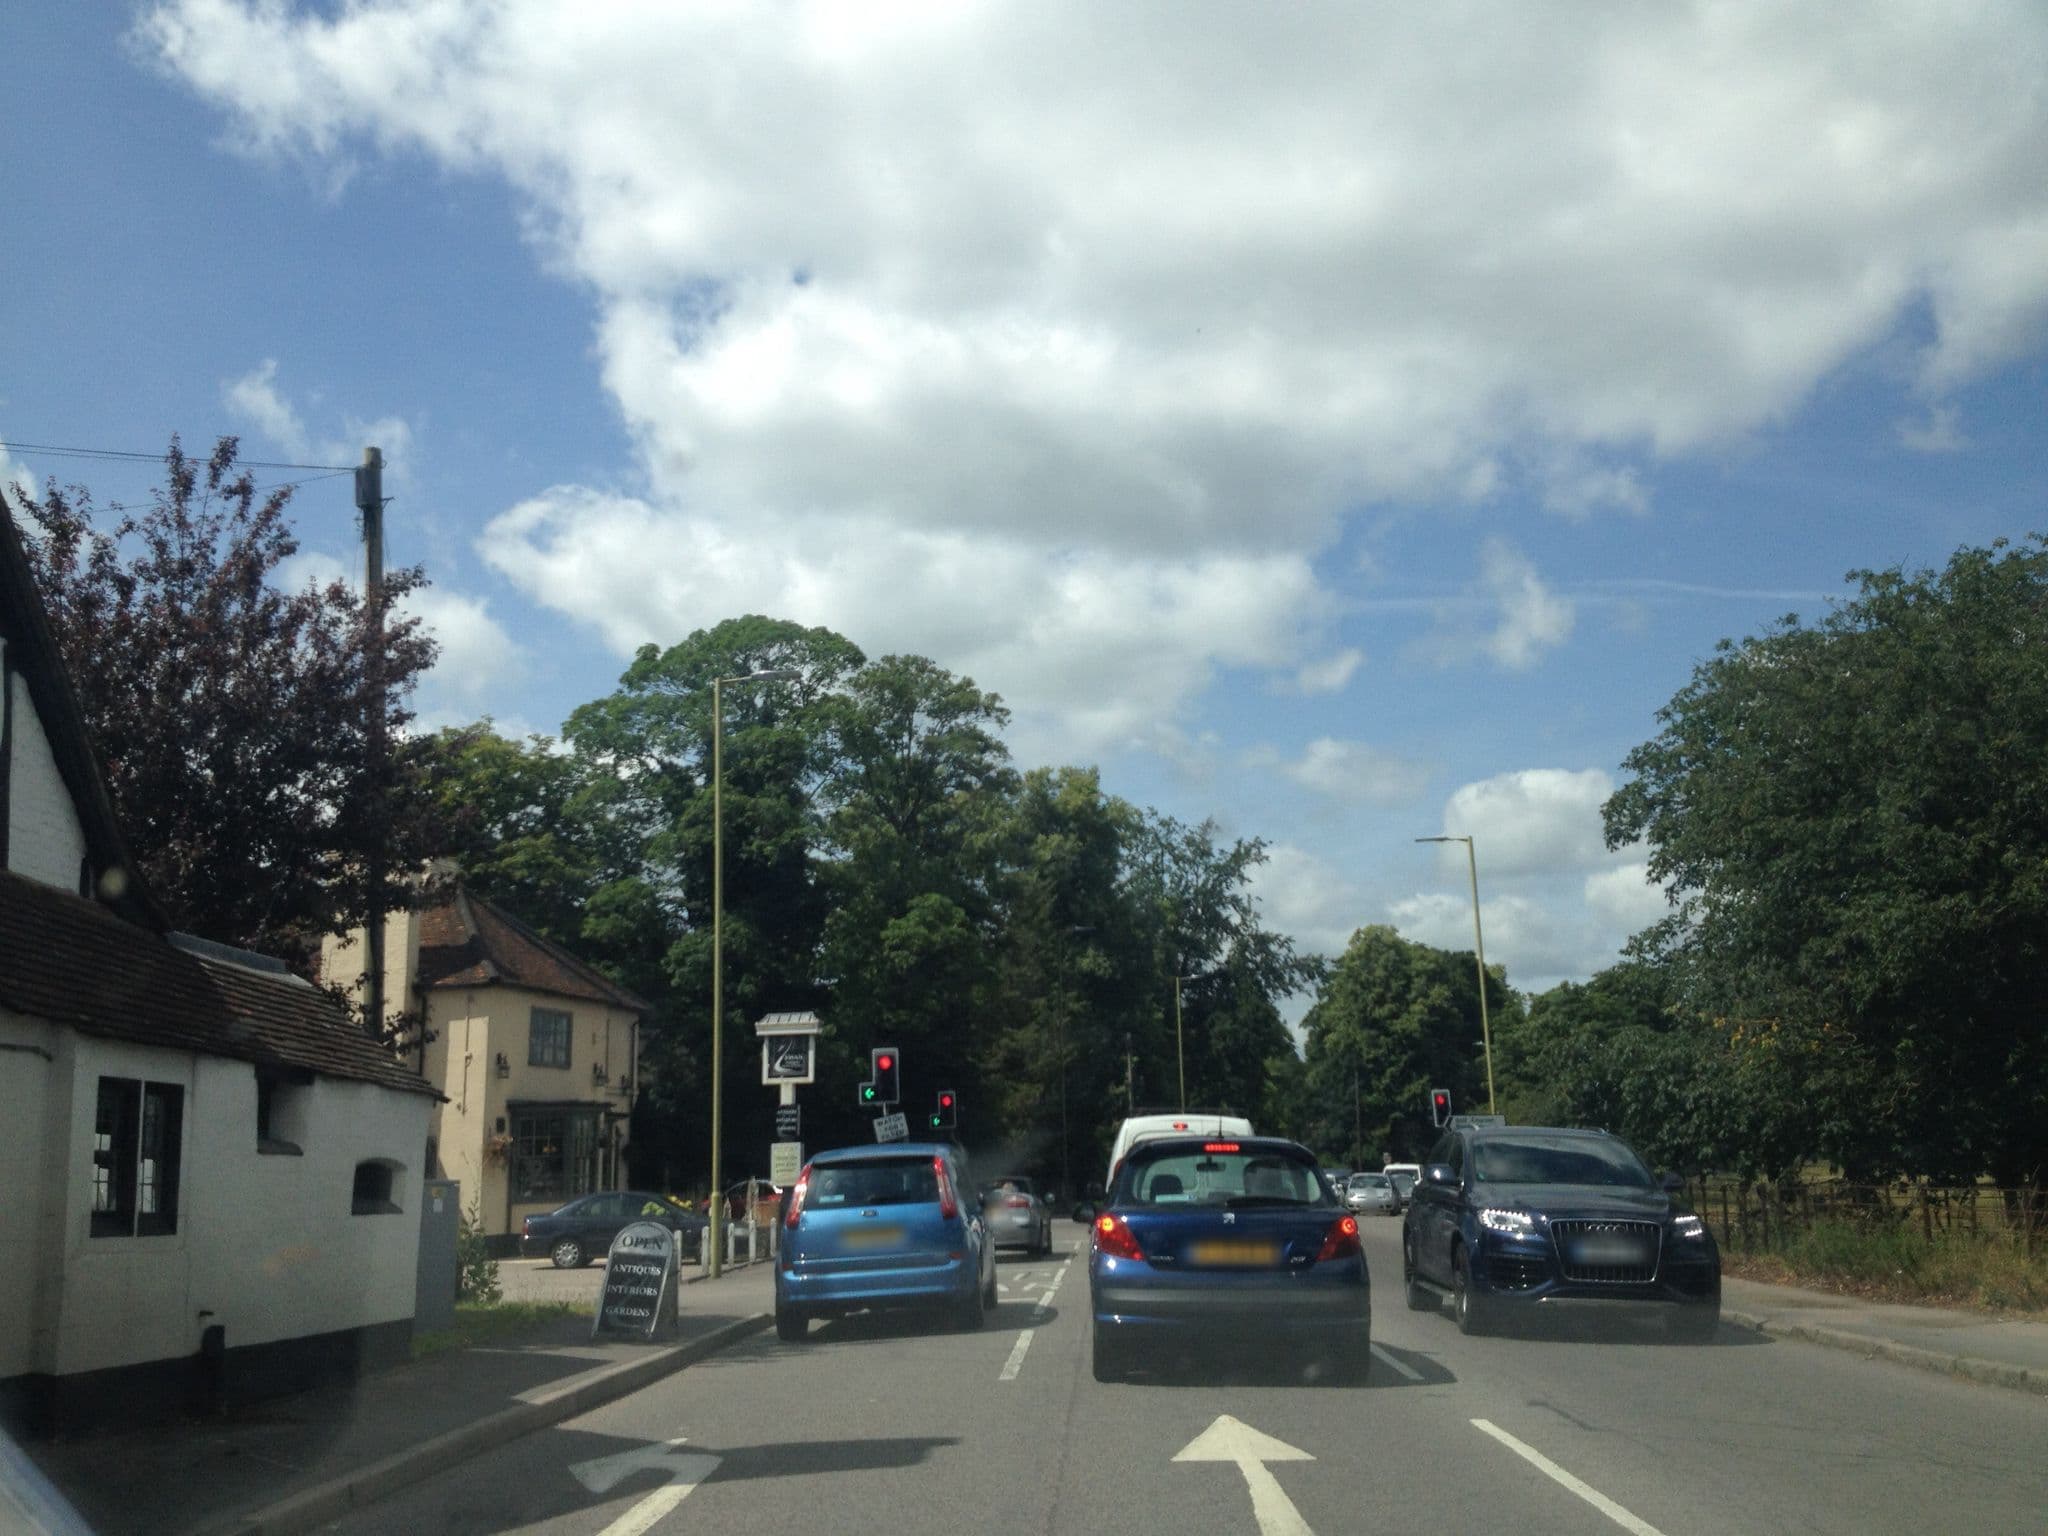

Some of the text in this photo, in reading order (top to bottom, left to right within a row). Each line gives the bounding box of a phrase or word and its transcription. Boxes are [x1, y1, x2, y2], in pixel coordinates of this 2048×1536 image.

[622, 1235, 665, 1250] OPEN
[612, 1264, 662, 1276] ANTIQUES
[605, 1306, 650, 1317] GARDENS
